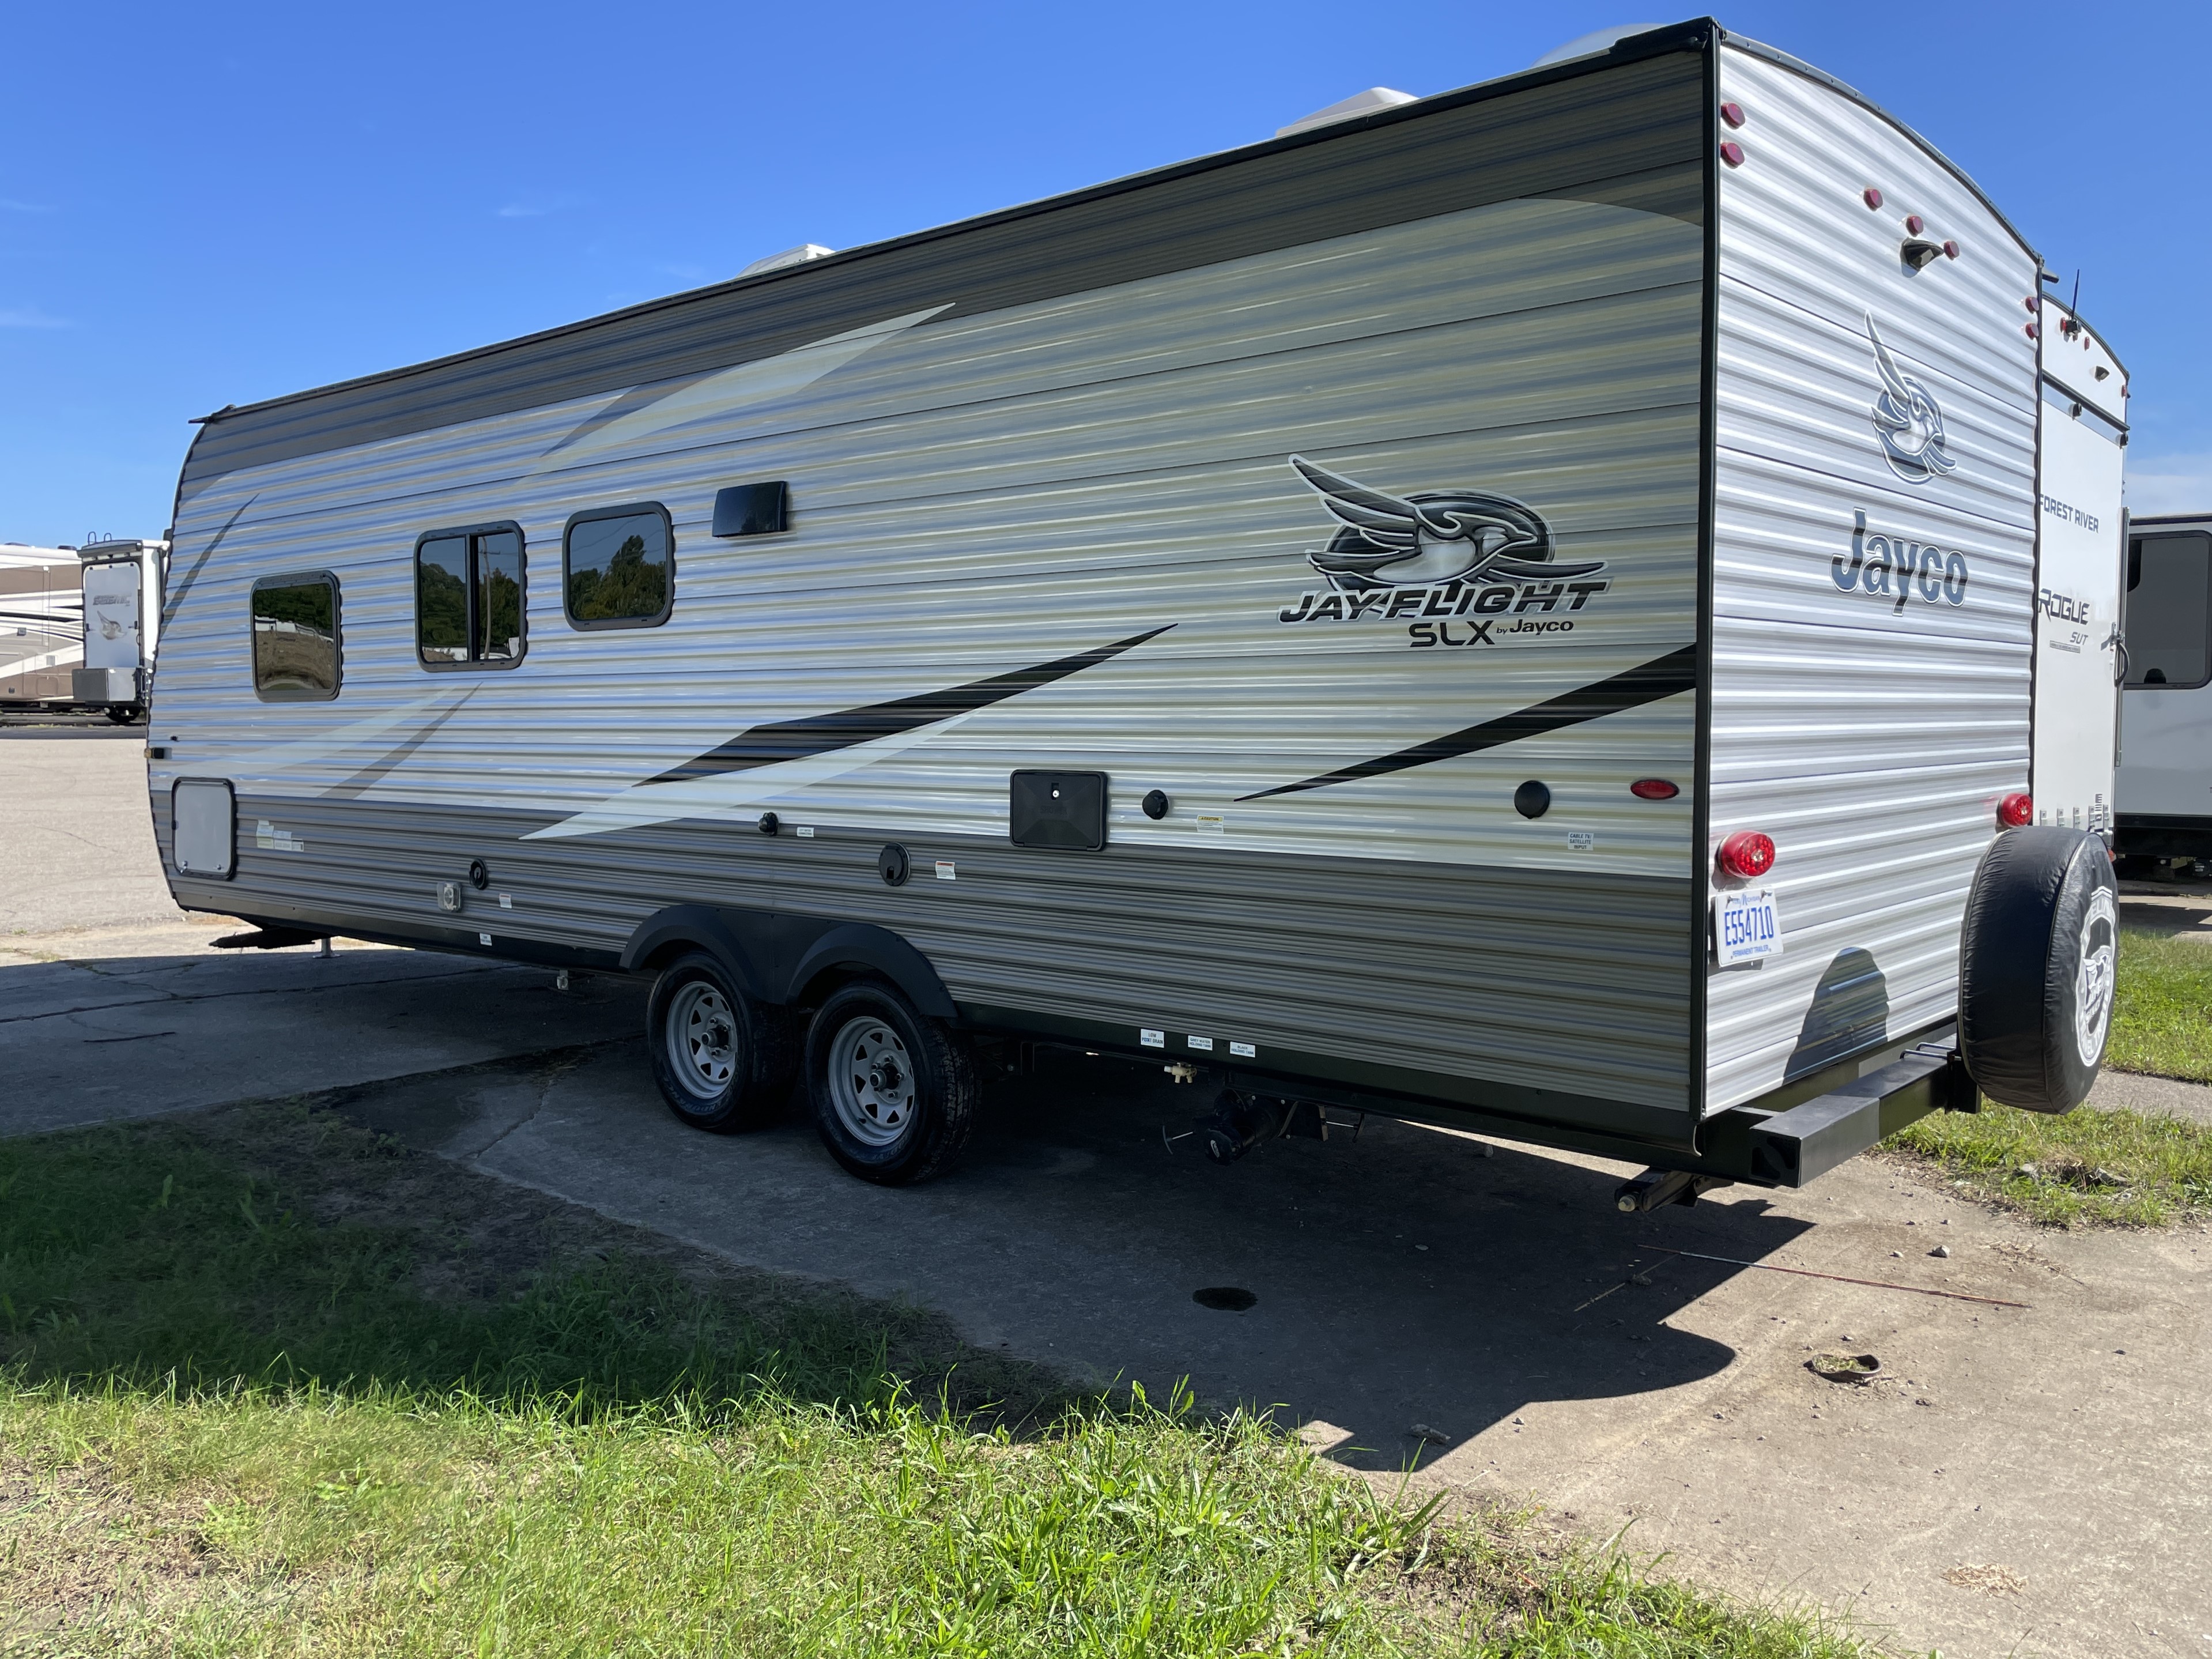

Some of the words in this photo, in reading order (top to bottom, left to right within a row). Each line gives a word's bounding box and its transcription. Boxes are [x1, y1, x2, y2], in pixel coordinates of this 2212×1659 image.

[2074, 508, 2099, 534] RIVER
[1830, 507, 1969, 617] Jayco
[1383, 580, 1609, 620] FLIGHT
[2038, 587, 2090, 625] ROGUE
[1409, 620, 1496, 648] SLX
[1497, 627, 1509, 635] by
[1509, 619, 1575, 636] Jayco
[2070, 631, 2089, 646] SUT
[1724, 906, 1774, 946] E554710
